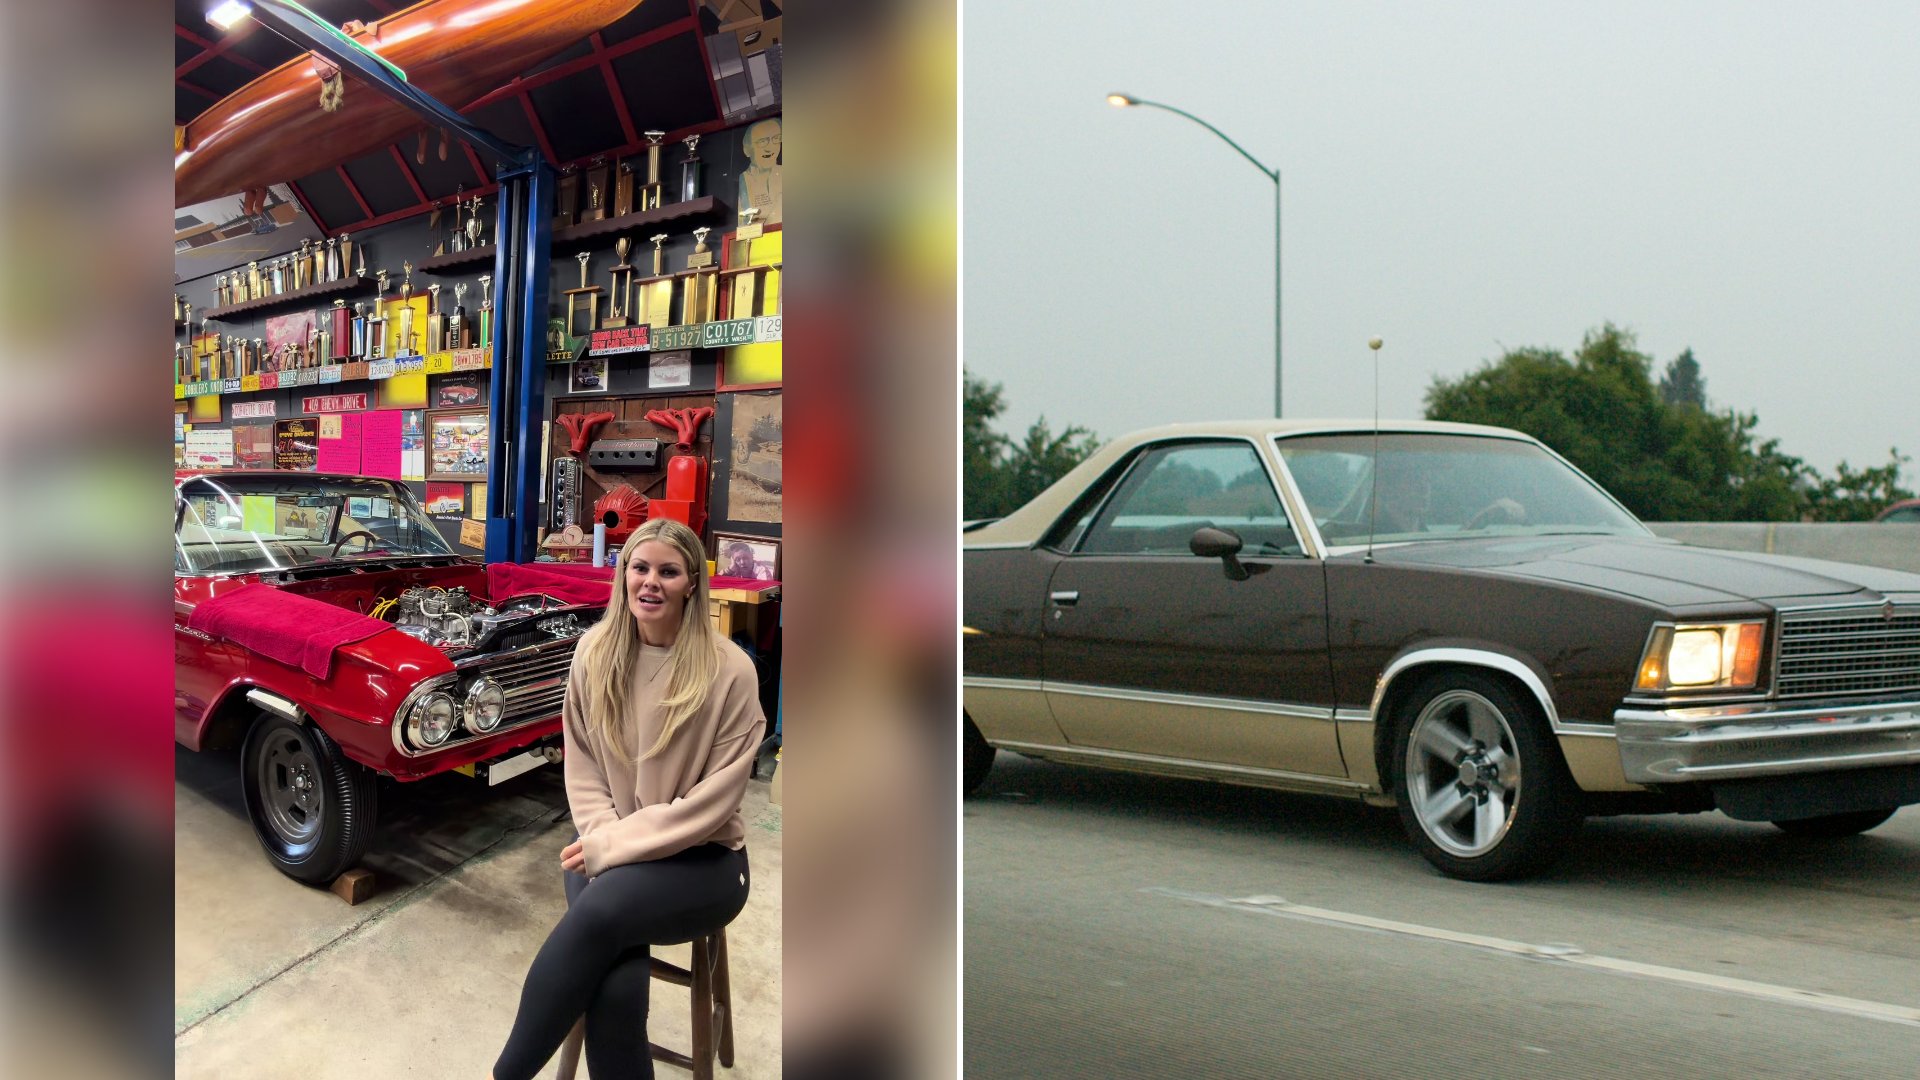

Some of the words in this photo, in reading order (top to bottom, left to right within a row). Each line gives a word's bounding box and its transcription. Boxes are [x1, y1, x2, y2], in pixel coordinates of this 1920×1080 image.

[607, 339, 620, 349] CAR
[652, 331, 701, 349] B-51927
[434, 358, 441, 367] 20
[210, 380, 224, 394] KNOB
[321, 397, 340, 410] CHEVY
[342, 395, 360, 409] DRIVE
